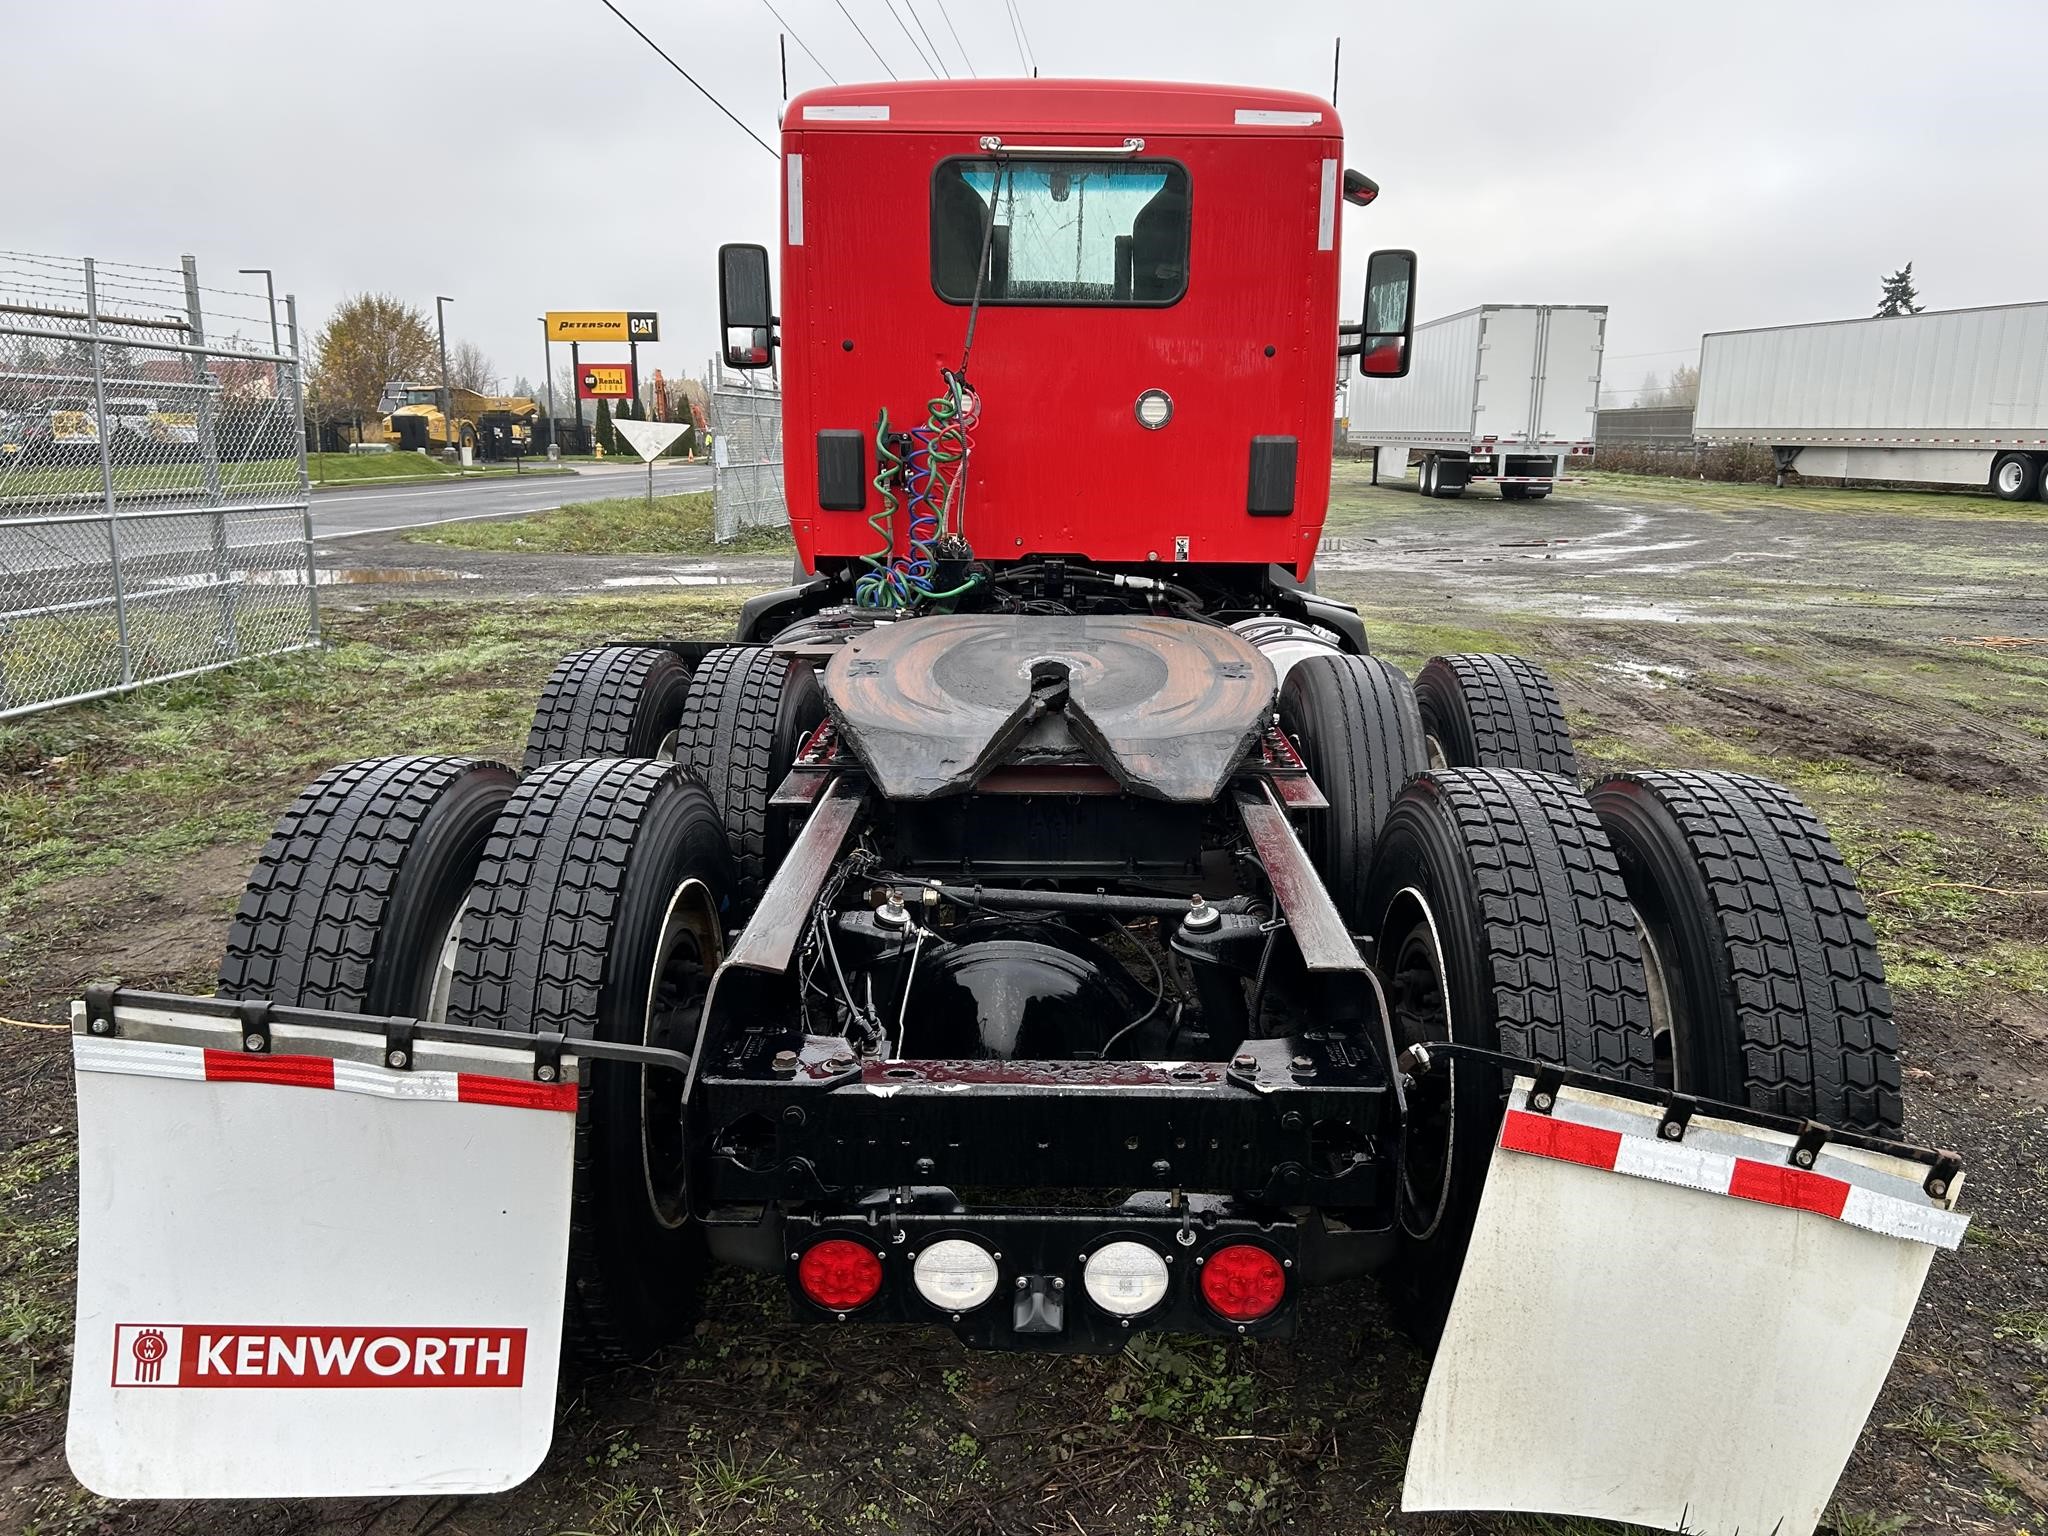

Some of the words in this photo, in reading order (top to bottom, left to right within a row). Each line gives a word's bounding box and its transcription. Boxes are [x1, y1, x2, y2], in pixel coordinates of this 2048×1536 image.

[559, 321, 622, 331] PETERSON
[631, 318, 654, 334] CAT
[598, 377, 623, 385] Rental
[197, 1335, 511, 1376] KENWORTH
